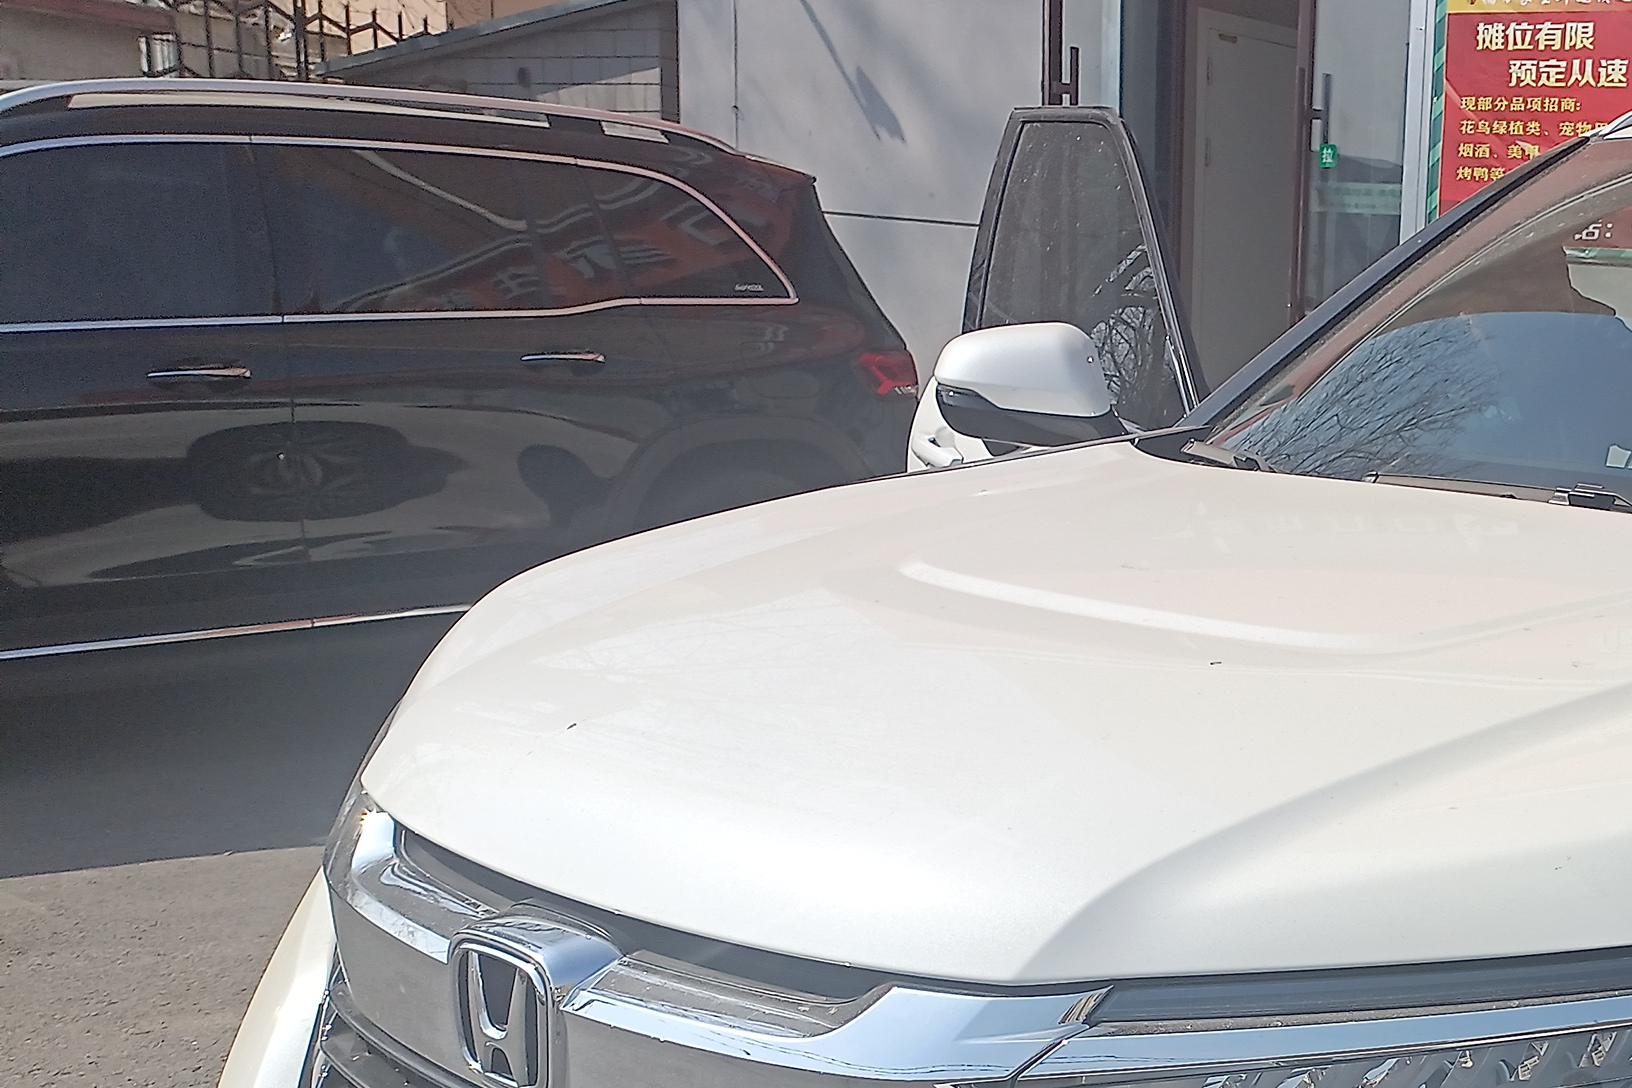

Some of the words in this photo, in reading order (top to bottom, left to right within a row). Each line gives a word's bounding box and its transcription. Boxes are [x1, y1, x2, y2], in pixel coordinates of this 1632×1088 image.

[1475, 22, 1595, 51] 摊位有限
[1507, 59, 1629, 88] 预定从速
